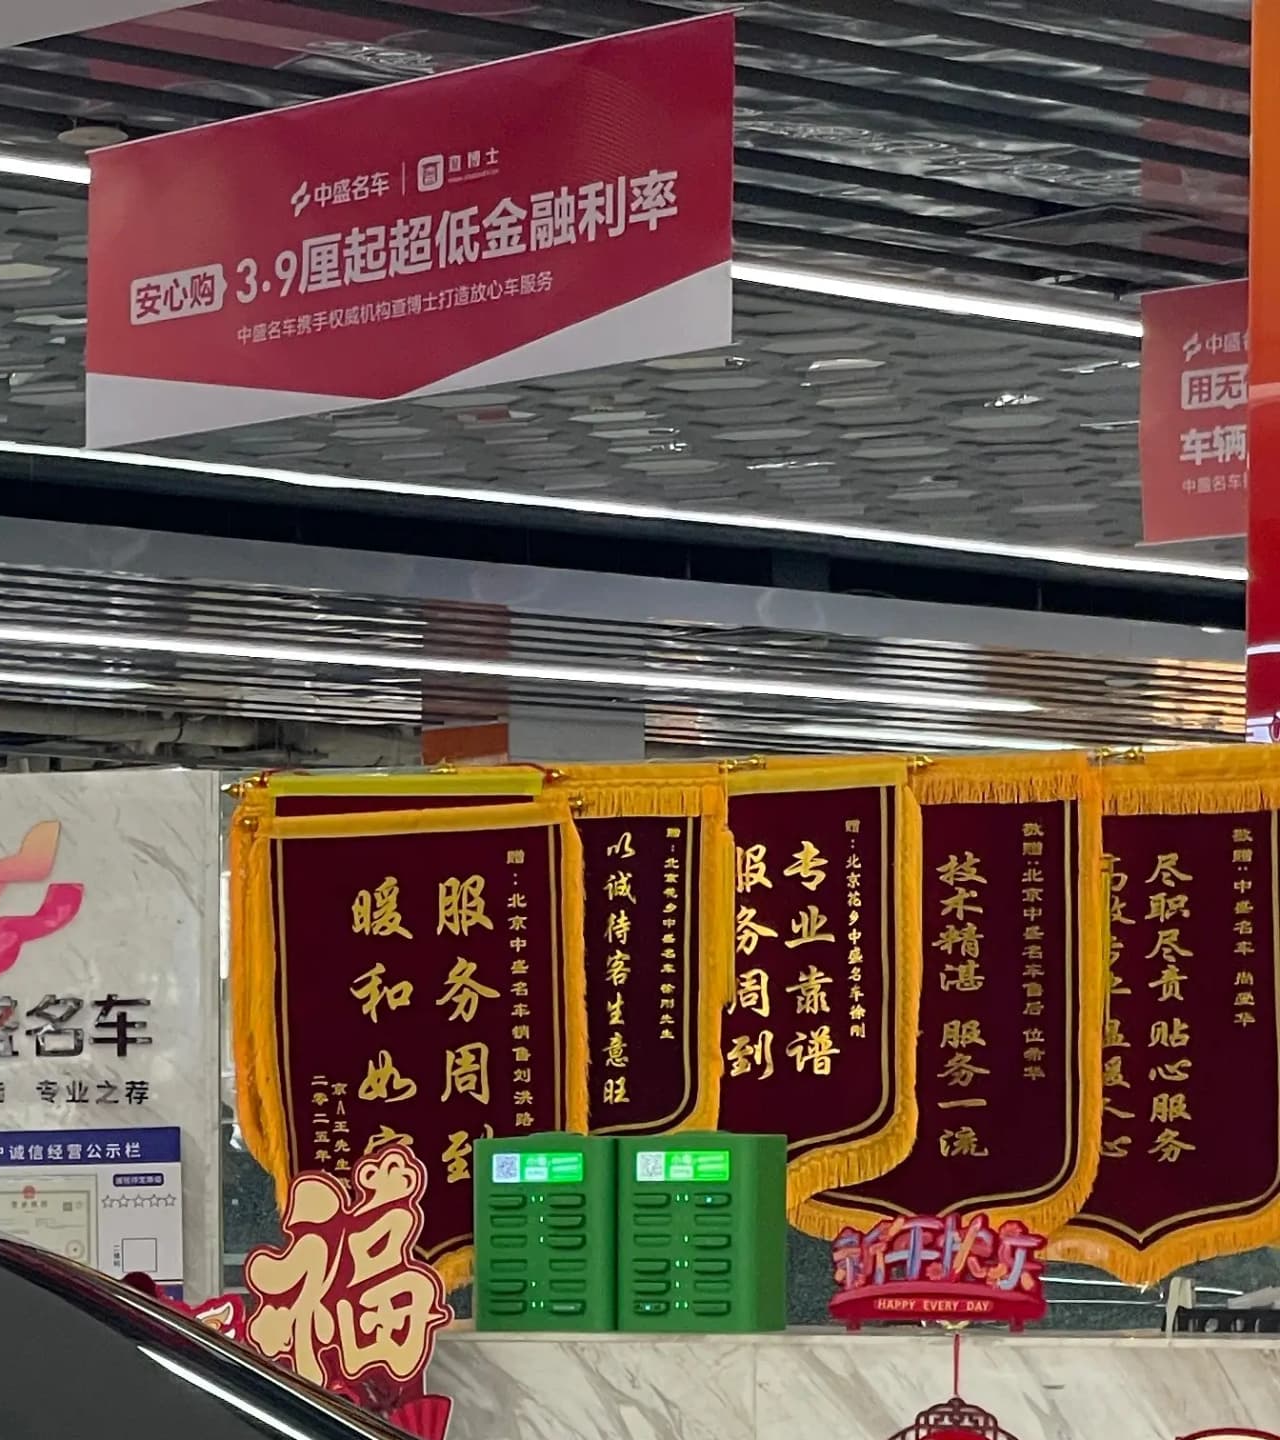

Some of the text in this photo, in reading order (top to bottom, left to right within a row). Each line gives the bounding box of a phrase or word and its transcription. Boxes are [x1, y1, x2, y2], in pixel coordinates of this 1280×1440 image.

[136, 169, 678, 319] 安心购 3.9厘起超低金融利率
[314, 172, 389, 207] 中盛名车
[1188, 373, 1248, 405] 用无
[1206, 332, 1249, 355] 中盛
[1182, 472, 1248, 494] 中盛名车
[351, 876, 417, 1157] 暖和如
[602, 831, 637, 1105] 以诚待客生意旺
[727, 843, 779, 1081] 服务周到
[783, 840, 840, 1076] 专业靠谱
[932, 851, 990, 1157] 技术精湛 服务一流
[1145, 852, 1196, 1163] 尽职尽责 贴心服务
[36, 1079, 150, 1106] 专业之荐
[248, 1152, 449, 1388] 福
[878, 1299, 991, 1312] HAPPY EVERY DAY
